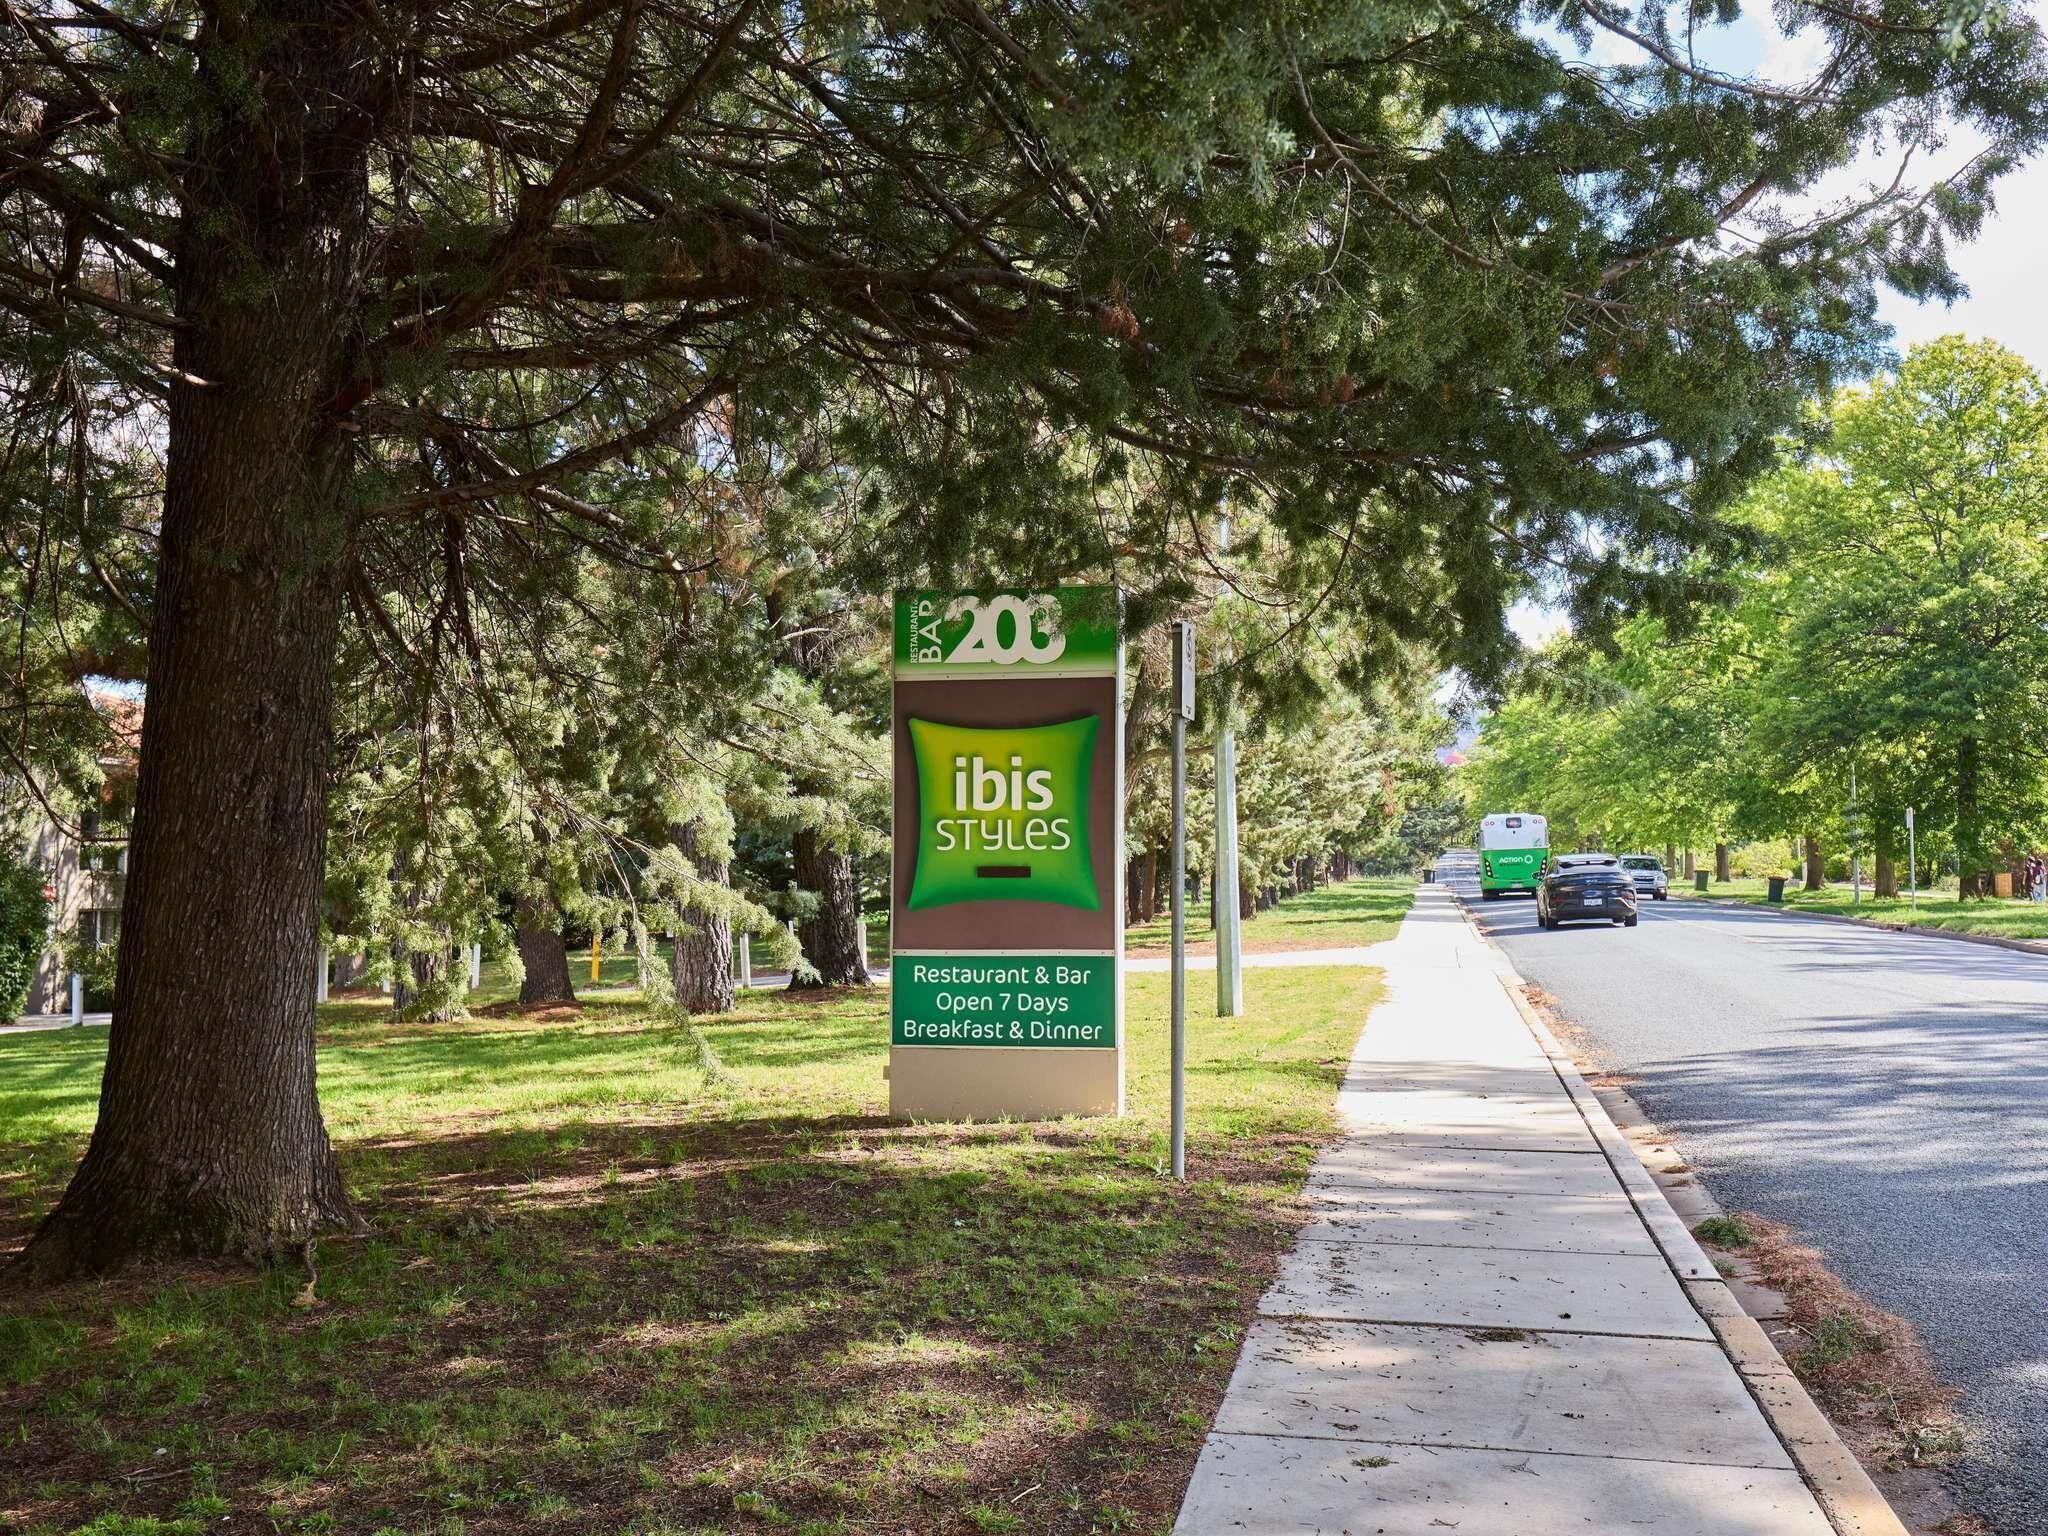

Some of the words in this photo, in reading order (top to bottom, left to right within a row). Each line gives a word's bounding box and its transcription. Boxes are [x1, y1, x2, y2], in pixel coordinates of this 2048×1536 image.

[944, 594, 1066, 665] 203
[955, 756, 1054, 812] ibis
[914, 965, 1029, 984] Restaurant
[1035, 966, 1050, 984] &
[1056, 966, 1091, 984] Bar
[936, 992, 993, 1014] Open
[999, 993, 1011, 1011] 7
[1018, 993, 1069, 1015] Days
[904, 1019, 1004, 1039] Breakfast
[1009, 1021, 1024, 1039] &
[1030, 1021, 1102, 1040] Dinner
